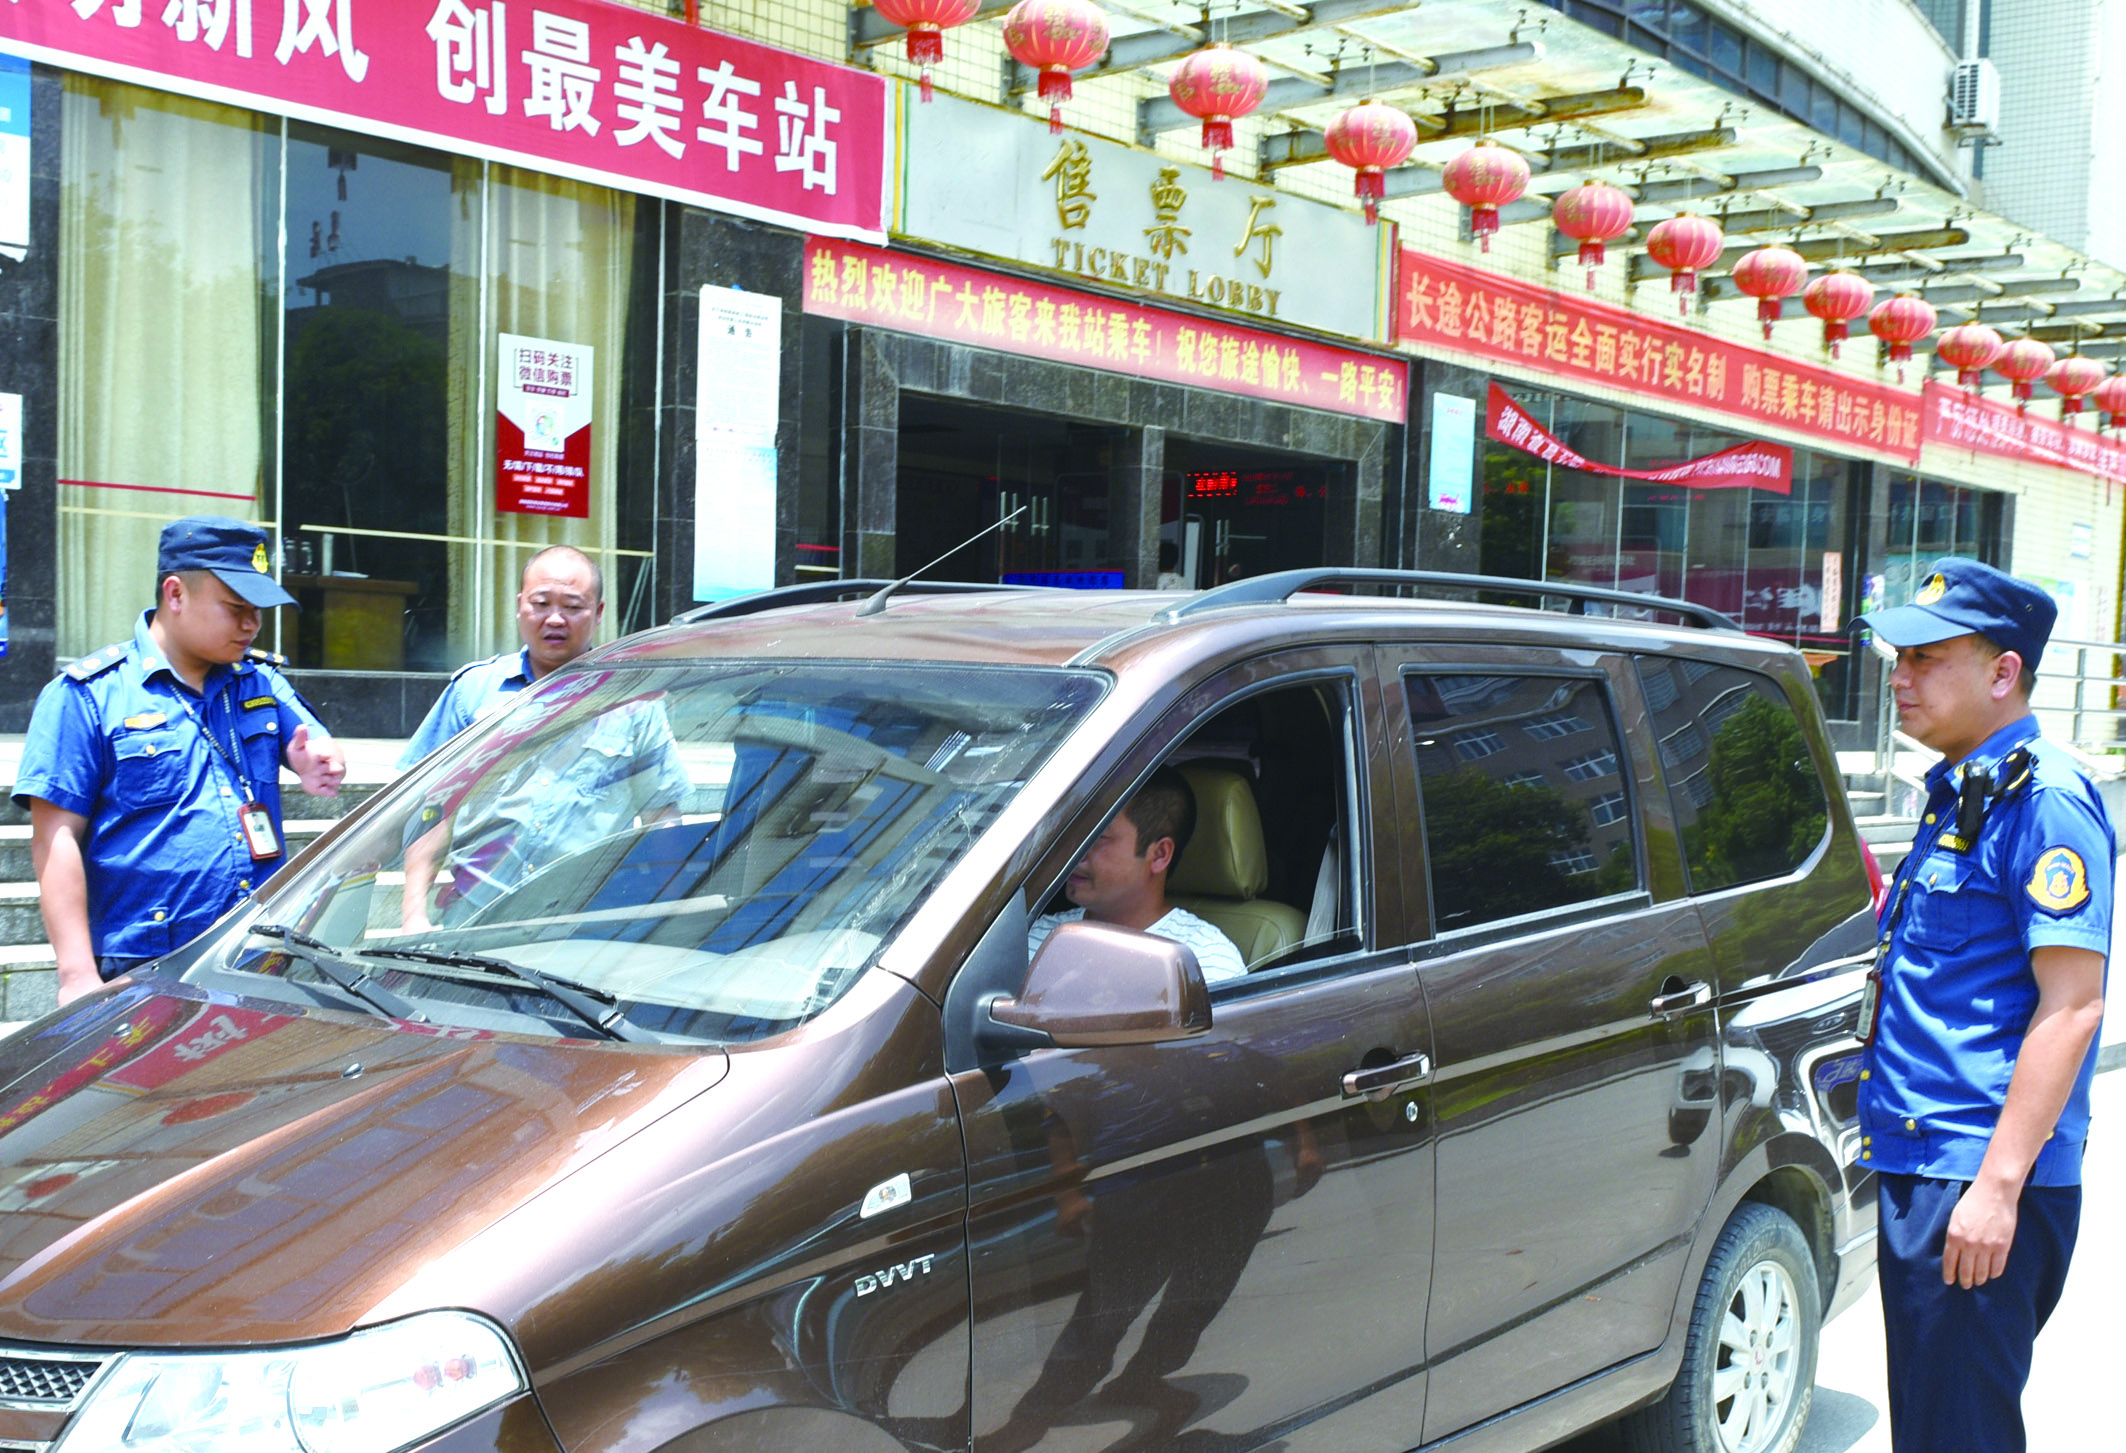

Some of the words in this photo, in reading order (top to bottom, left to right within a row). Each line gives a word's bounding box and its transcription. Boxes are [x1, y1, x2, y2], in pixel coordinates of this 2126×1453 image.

[425, 0, 841, 195] 创最美车站
[1042, 139, 1282, 279] 售票厅
[1051, 237, 1169, 291] TICKET
[1187, 269, 1282, 316] LOBBY
[519, 348, 573, 369] 扫码关注
[519, 366, 573, 386] 微信购票
[1406, 272, 1727, 401] 长途公路客运全面实行实名制
[1741, 363, 1918, 449] 购票乘车请出示身份证
[854, 1253, 935, 1297] DVVT
